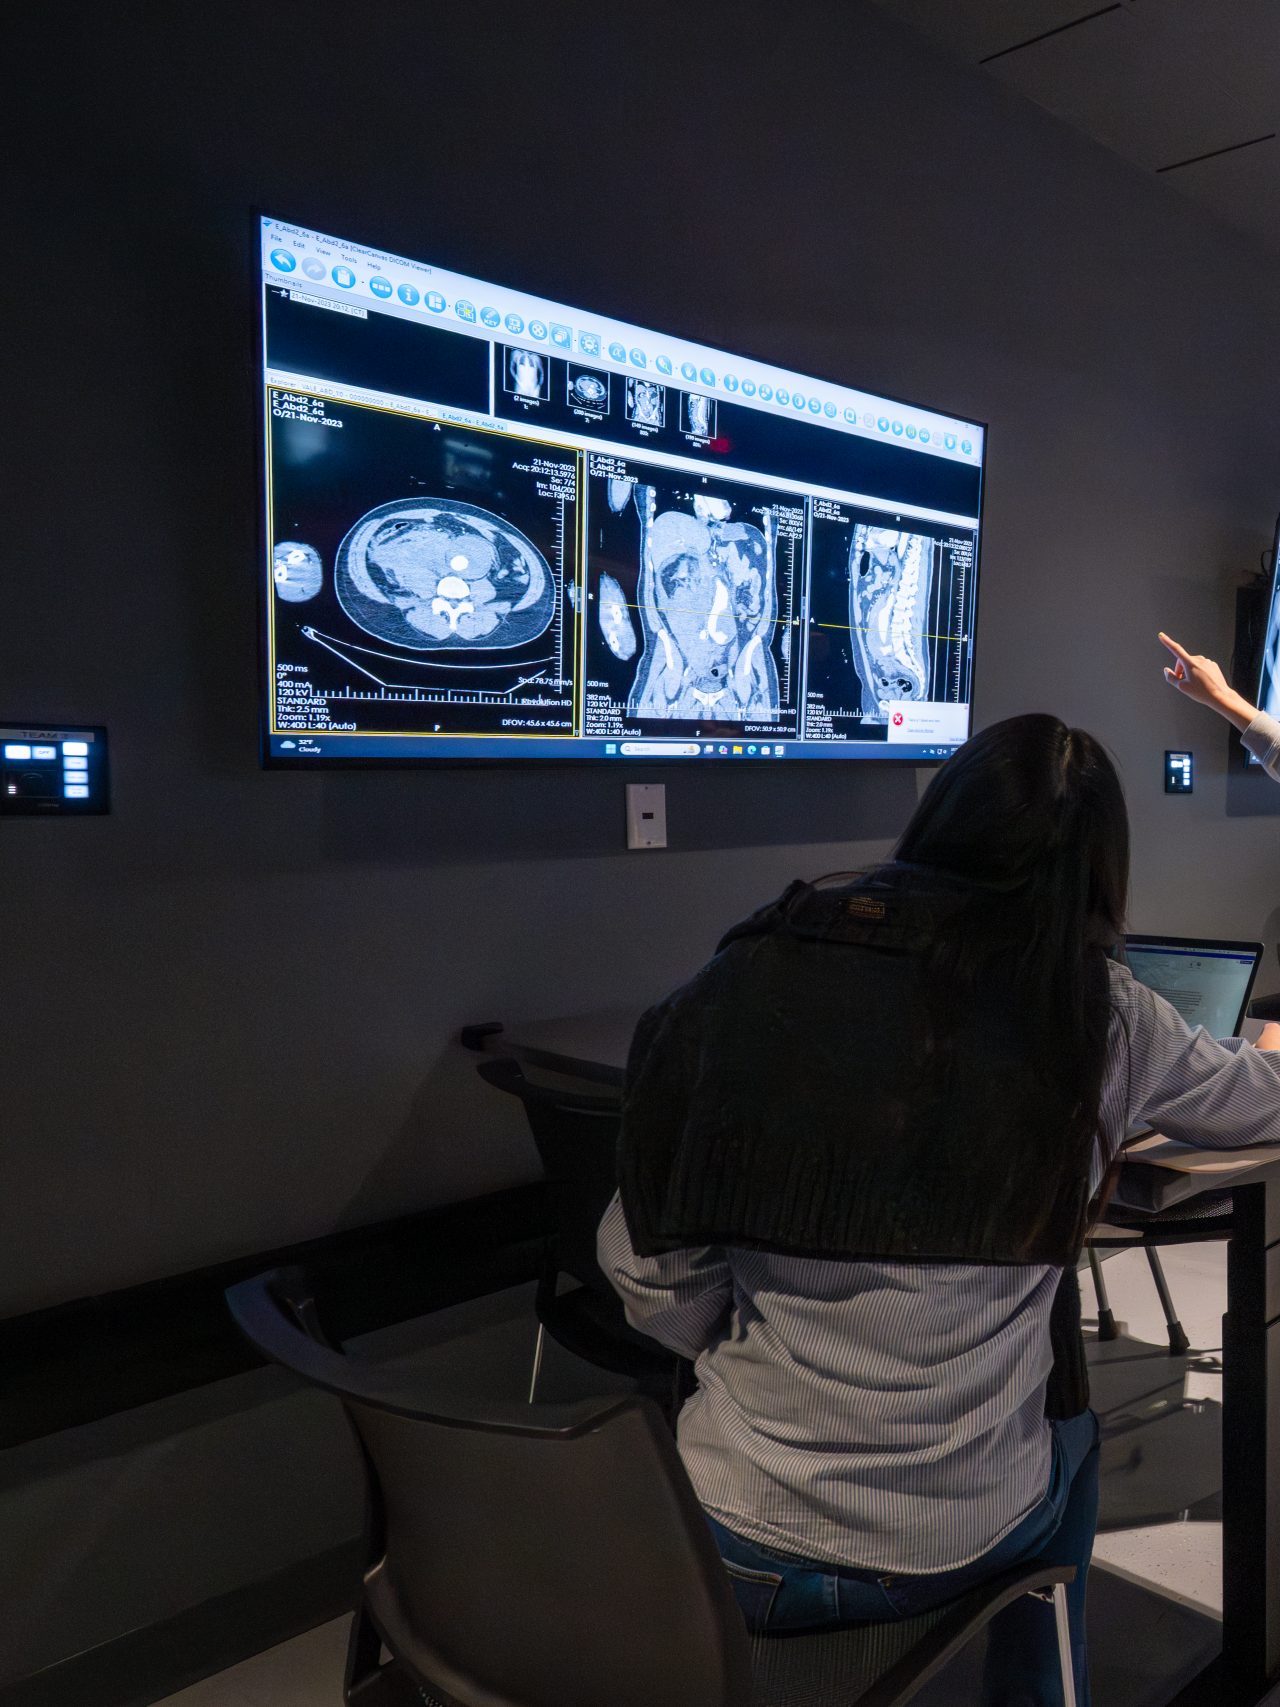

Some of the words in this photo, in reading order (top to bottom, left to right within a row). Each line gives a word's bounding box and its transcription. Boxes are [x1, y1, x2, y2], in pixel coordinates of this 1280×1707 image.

[270, 233, 283, 243] File
[292, 240, 305, 249] Edit
[315, 246, 331, 256] View
[340, 253, 358, 264] Tools
[388, 256, 410, 268] DICOM
[367, 262, 381, 271] Help
[264, 272, 303, 288] Thumbnails
[291, 293, 331, 308] 21-Nov-2023
[272, 391, 325, 408] E_Abd2_6a
[272, 400, 325, 416] E_Abd2_6a
[272, 409, 343, 428] O/21-Nov-2023
[433, 423, 441, 431] A
[532, 458, 576, 473] 21-Nov-2023
[589, 454, 626, 467] E_Abd2_6a
[512, 462, 530, 472] Acq:
[589, 461, 626, 474] E_Abd2_6a
[550, 476, 563, 484] Se:
[563, 478, 576, 487] 7/4
[589, 469, 639, 484] O/21-Nov-2023
[702, 476, 708, 484] H
[536, 481, 548, 490] Im:
[538, 489, 554, 498] Loc:
[772, 504, 804, 515] 21-Nov-2023
[813, 499, 840, 510] E_Abd2_6a
[813, 505, 840, 516] E_Abd2_6a
[588, 592, 594, 600] R
[276, 663, 294, 672] 500
[294, 665, 309, 673] ms
[294, 681, 311, 689] mA
[535, 677, 554, 685] 78.75
[278, 688, 294, 696] 120
[295, 689, 309, 697] kV
[276, 697, 327, 706] STANDARD
[276, 705, 296, 713] Thk:
[277, 713, 307, 721] Zoom:
[308, 714, 331, 722] 1.19x
[307, 722, 327, 730] L:40
[328, 722, 357, 731] (Auto)
[434, 724, 441, 732] P
[298, 746, 322, 754] Cloudy
